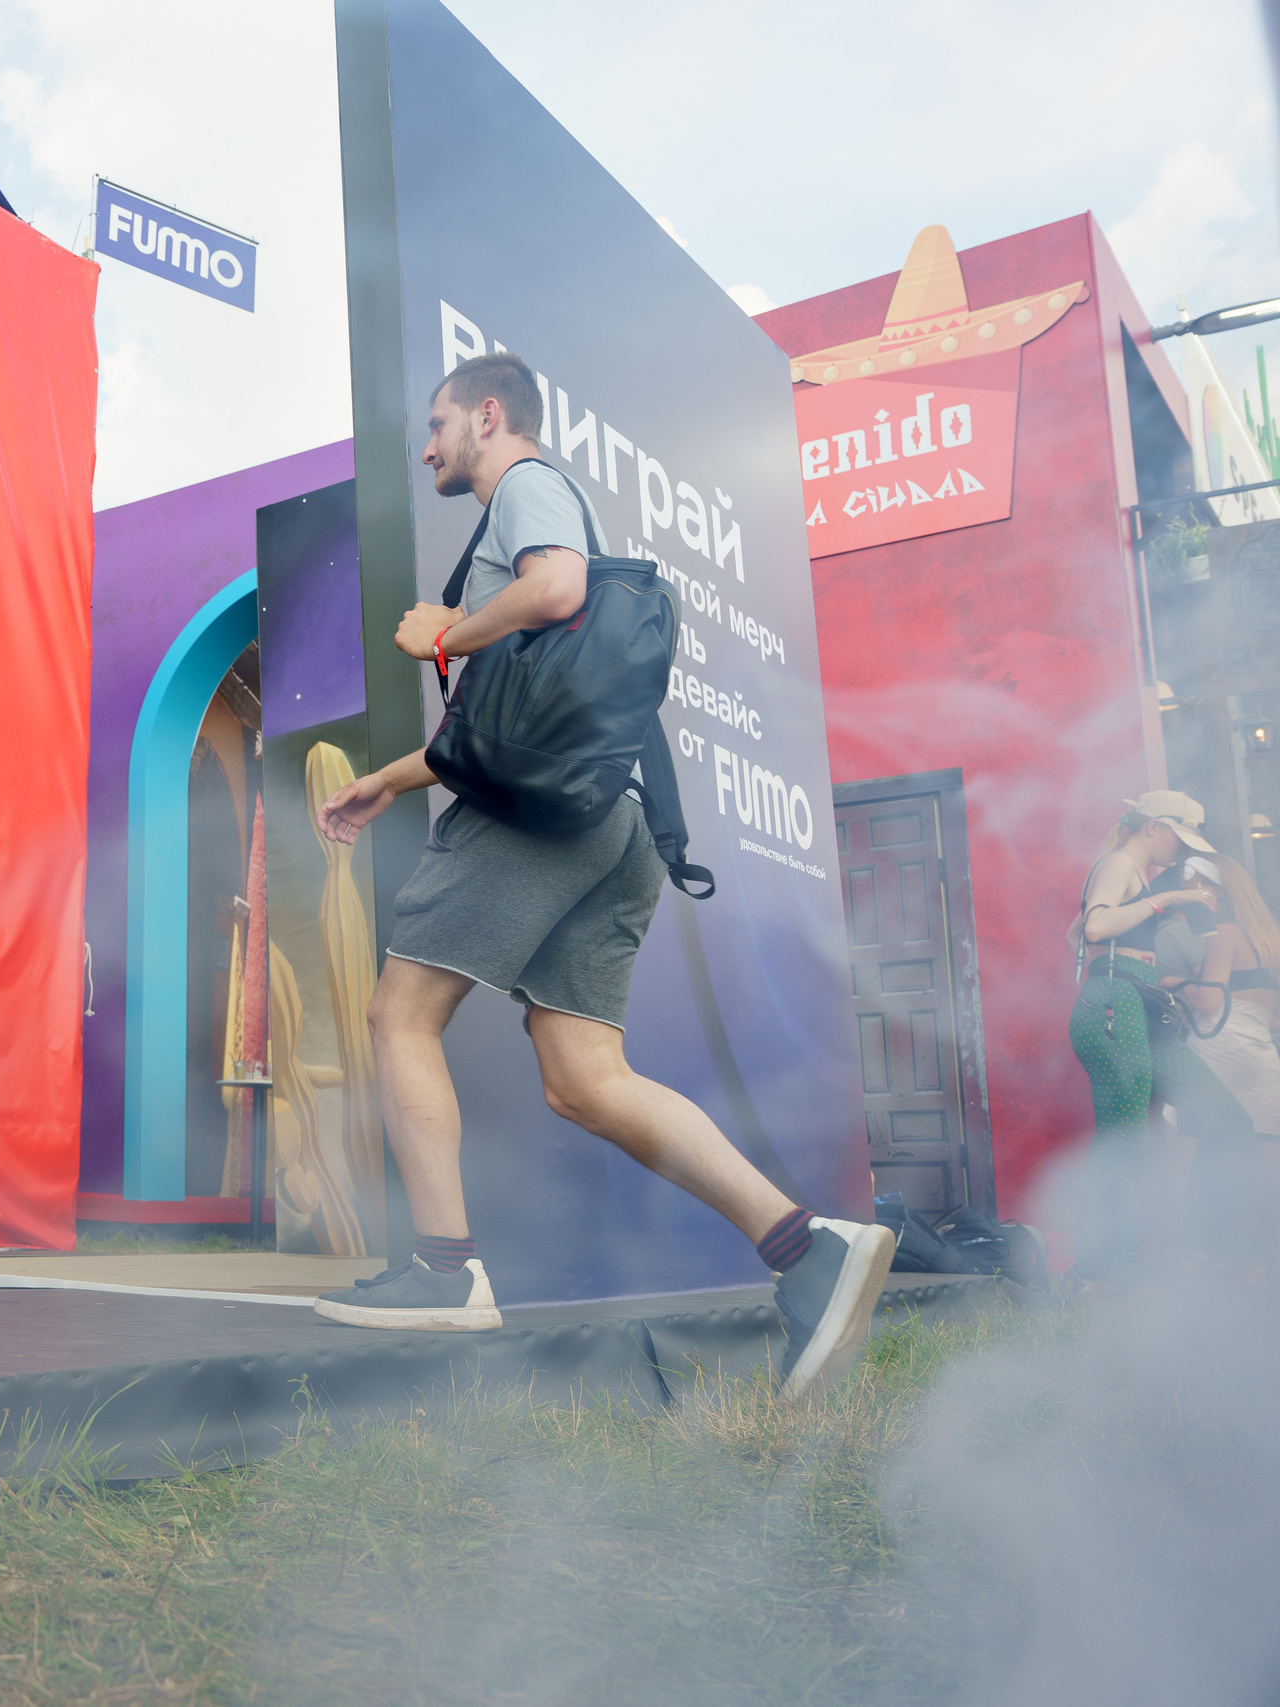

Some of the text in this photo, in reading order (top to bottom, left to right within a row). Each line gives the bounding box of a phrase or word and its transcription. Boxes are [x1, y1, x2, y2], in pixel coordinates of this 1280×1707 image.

[108, 203, 244, 288] FUMO
[801, 391, 973, 482] enido
[805, 498, 828, 527] A
[728, 603, 786, 665] мерч
[668, 665, 763, 741] девайс
[678, 727, 814, 850] от FUMO
[739, 837, 827, 881] удовольствие быть собой
